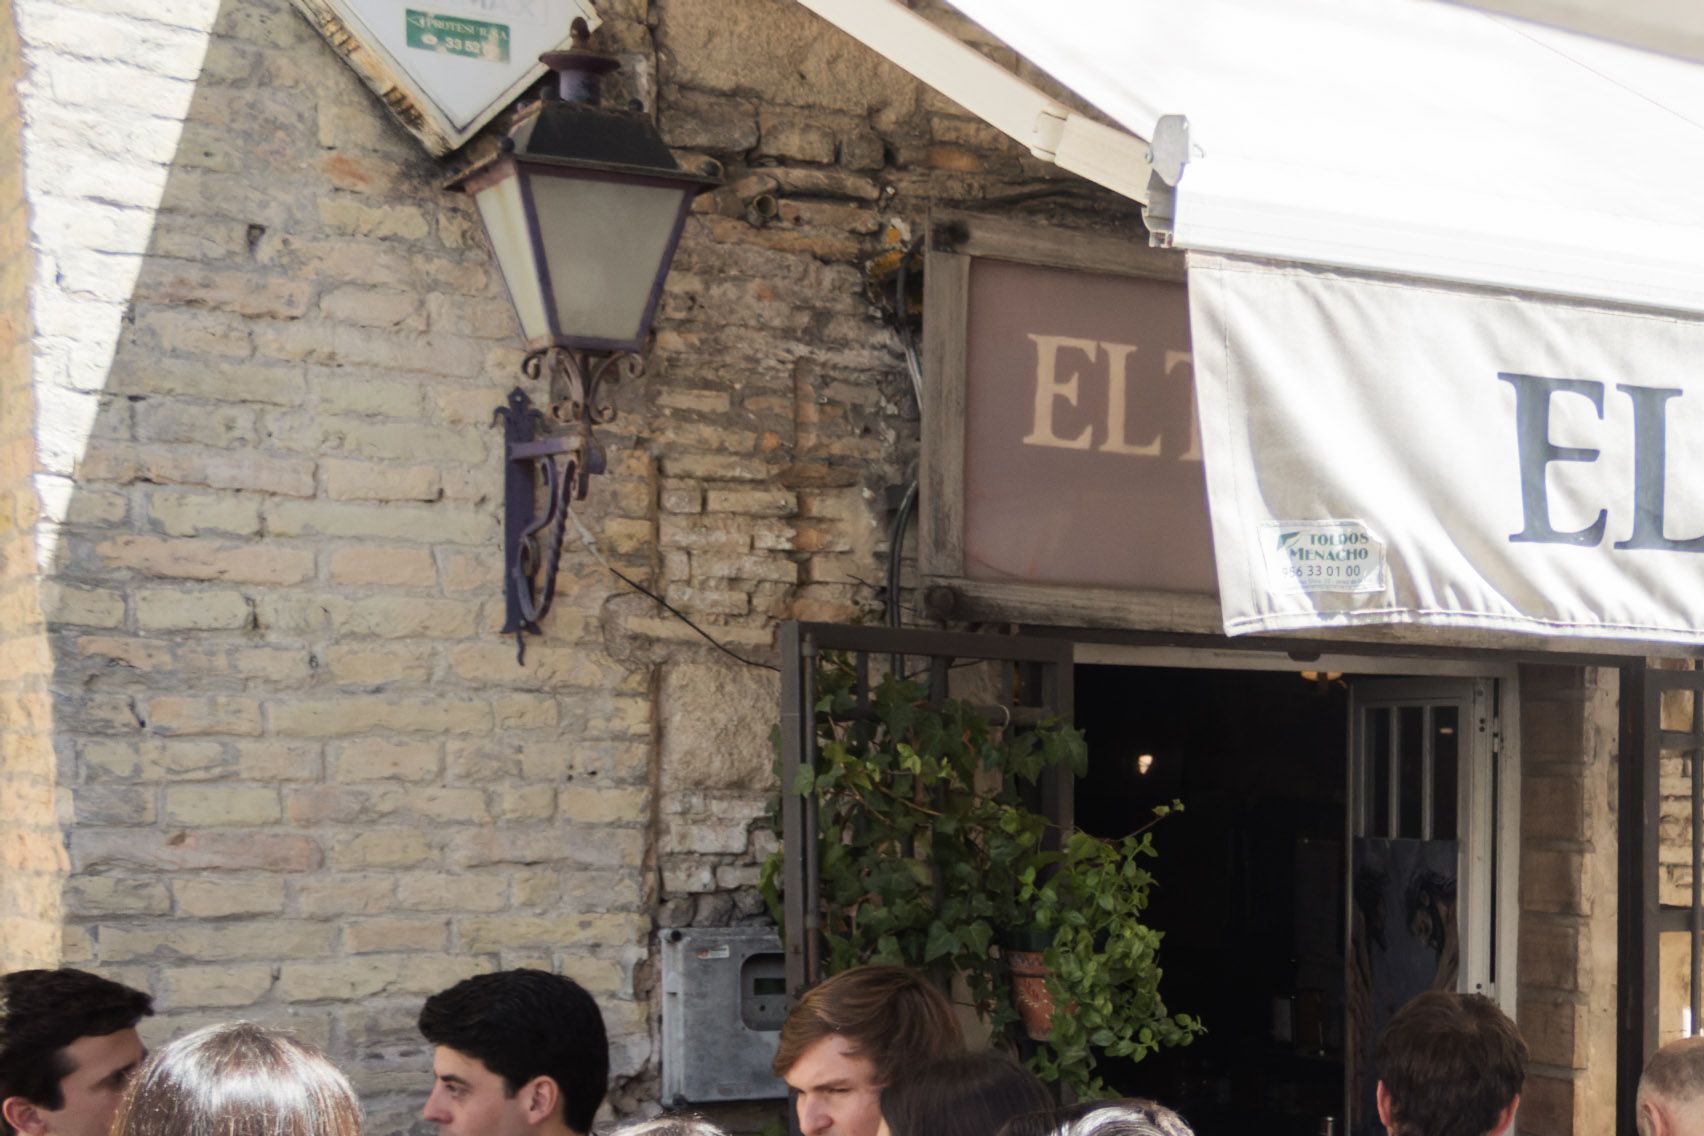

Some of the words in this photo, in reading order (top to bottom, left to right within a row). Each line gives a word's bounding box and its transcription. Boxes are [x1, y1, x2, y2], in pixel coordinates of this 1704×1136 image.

[1022, 333, 1162, 456] EL
[1309, 532, 1369, 546] TOLDOS
[1289, 547, 1369, 561] MENACHO
[1307, 565, 1322, 577] 33
[1326, 565, 1341, 577] 01
[1345, 564, 1361, 577] 00
